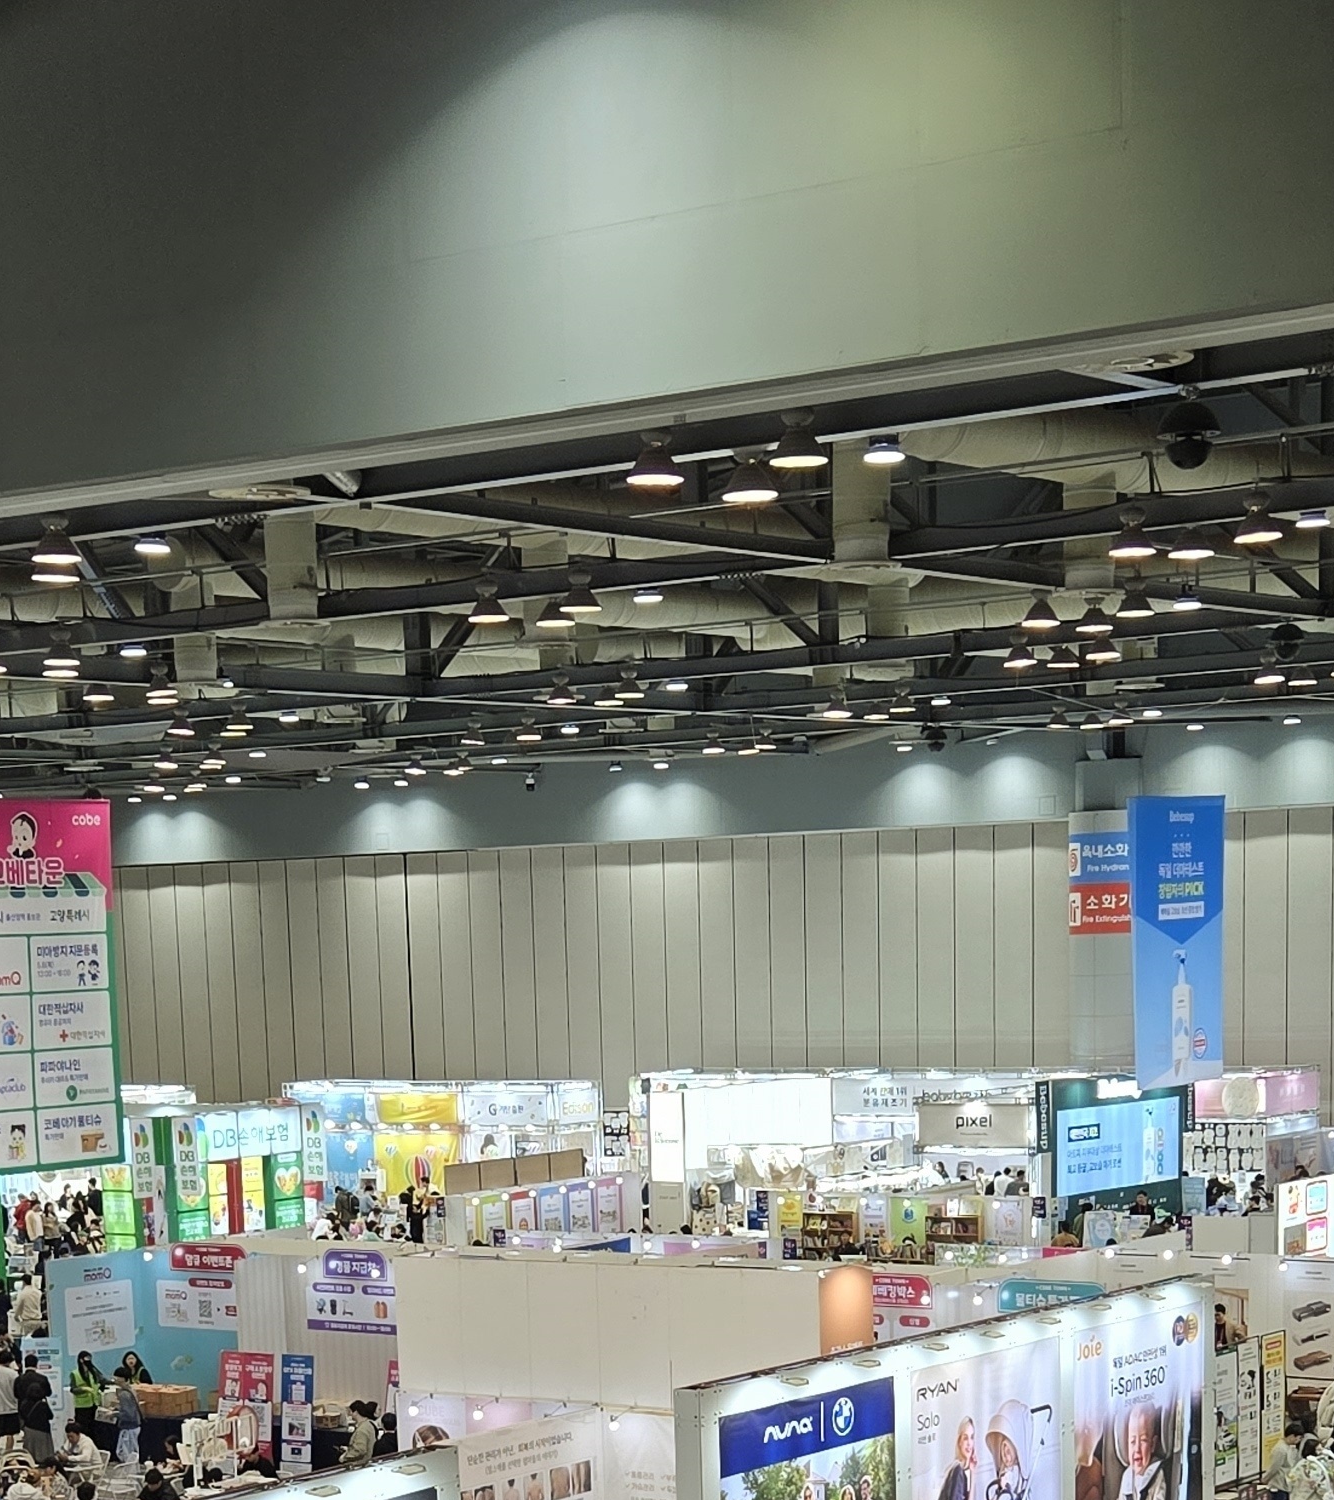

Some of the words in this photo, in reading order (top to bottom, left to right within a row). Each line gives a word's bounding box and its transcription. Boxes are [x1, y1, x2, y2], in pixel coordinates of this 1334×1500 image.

[72, 813, 101, 826] cobe
[1082, 843, 1129, 858] 옥내소화
[1087, 864, 1099, 872] Fire
[1101, 863, 1130, 872] Hydran
[49, 909, 90, 924] 고양특례시
[1082, 915, 1094, 924] Fire
[1095, 914, 1131, 924] Extinguish
[38, 1002, 84, 1015] 대한적십자사
[955, 1113, 992, 1129] pixel
[306, 1137, 322, 1149] DB
[136, 1152, 151, 1164] DB
[180, 1150, 195, 1162] DB
[84, 1268, 112, 1281] momQ
[1077, 1335, 1102, 1361] Joie
[1110, 1373, 1142, 1397] i-Spin
[1143, 1366, 1166, 1388] 360
[916, 1379, 959, 1402] RYAN
[917, 1411, 940, 1431] Solo
[763, 1415, 815, 1442] nuna
